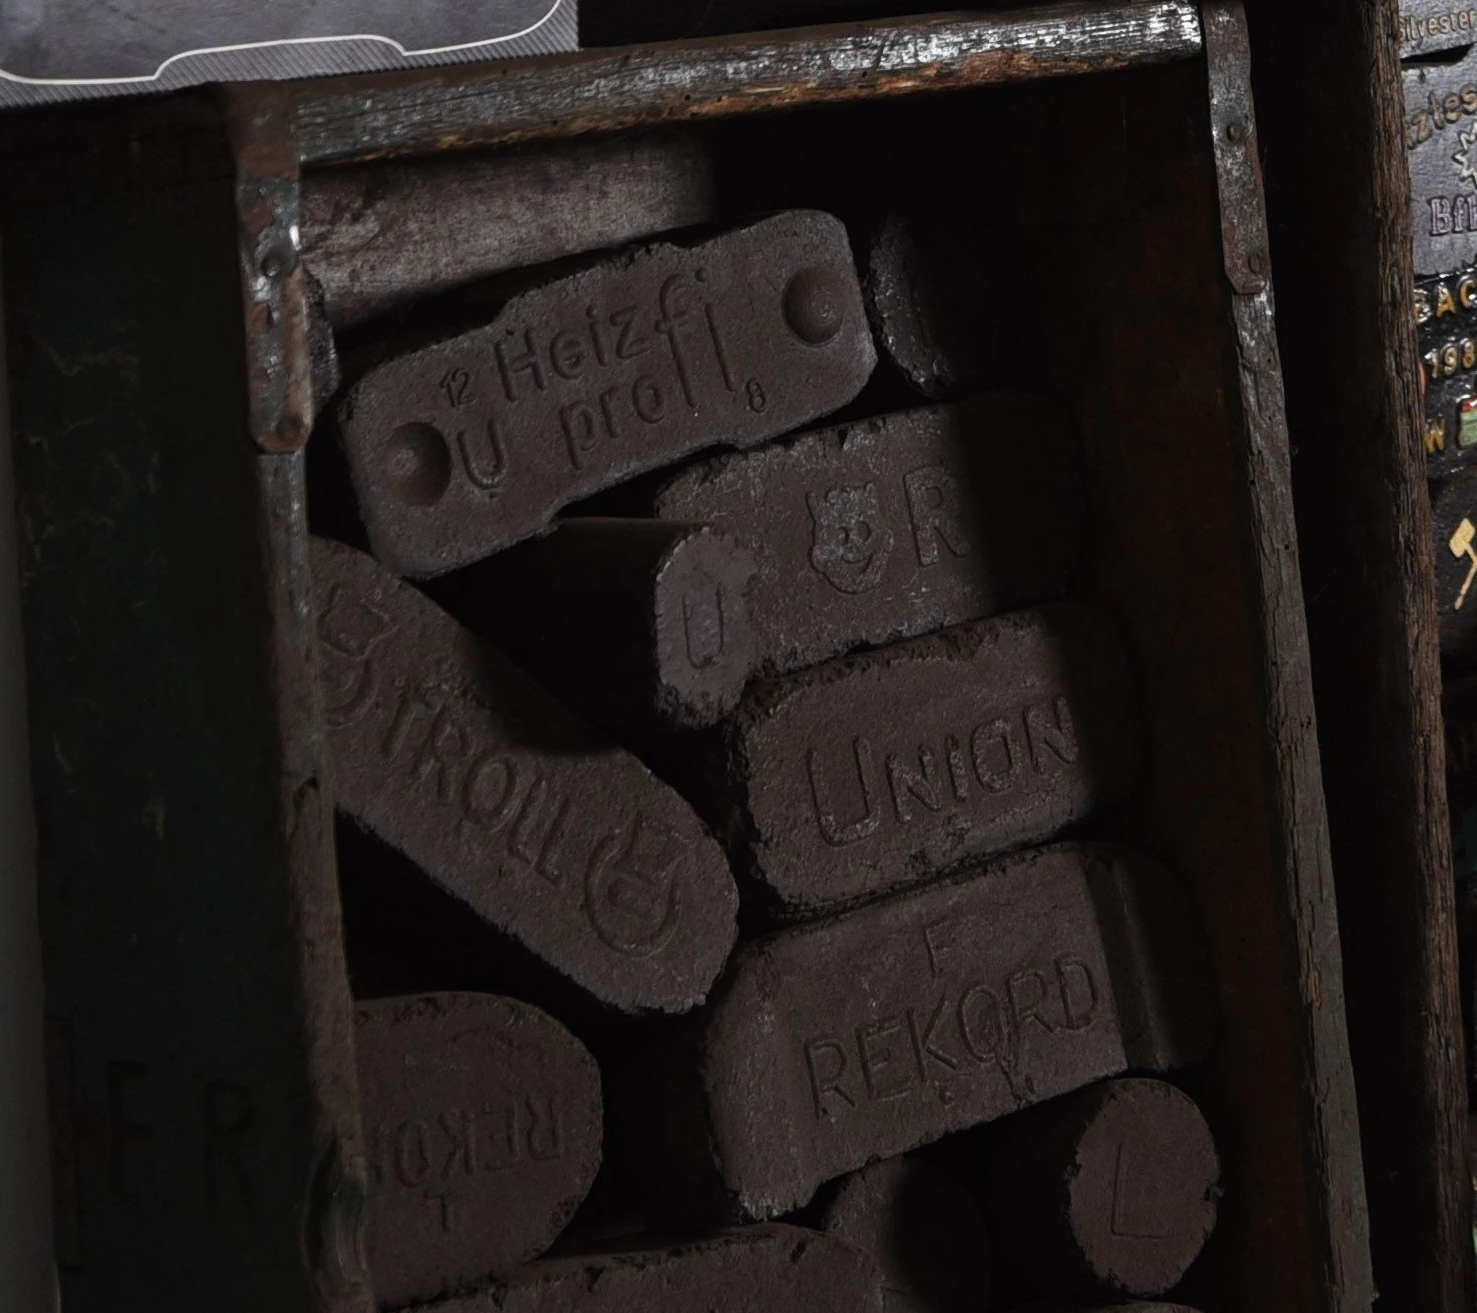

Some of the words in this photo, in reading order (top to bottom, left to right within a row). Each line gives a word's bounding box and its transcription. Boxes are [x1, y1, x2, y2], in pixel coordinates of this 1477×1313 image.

[381, 677, 572, 887] TROLL
[807, 695, 1079, 848] UNION
[802, 951, 1099, 1120] REKORD
